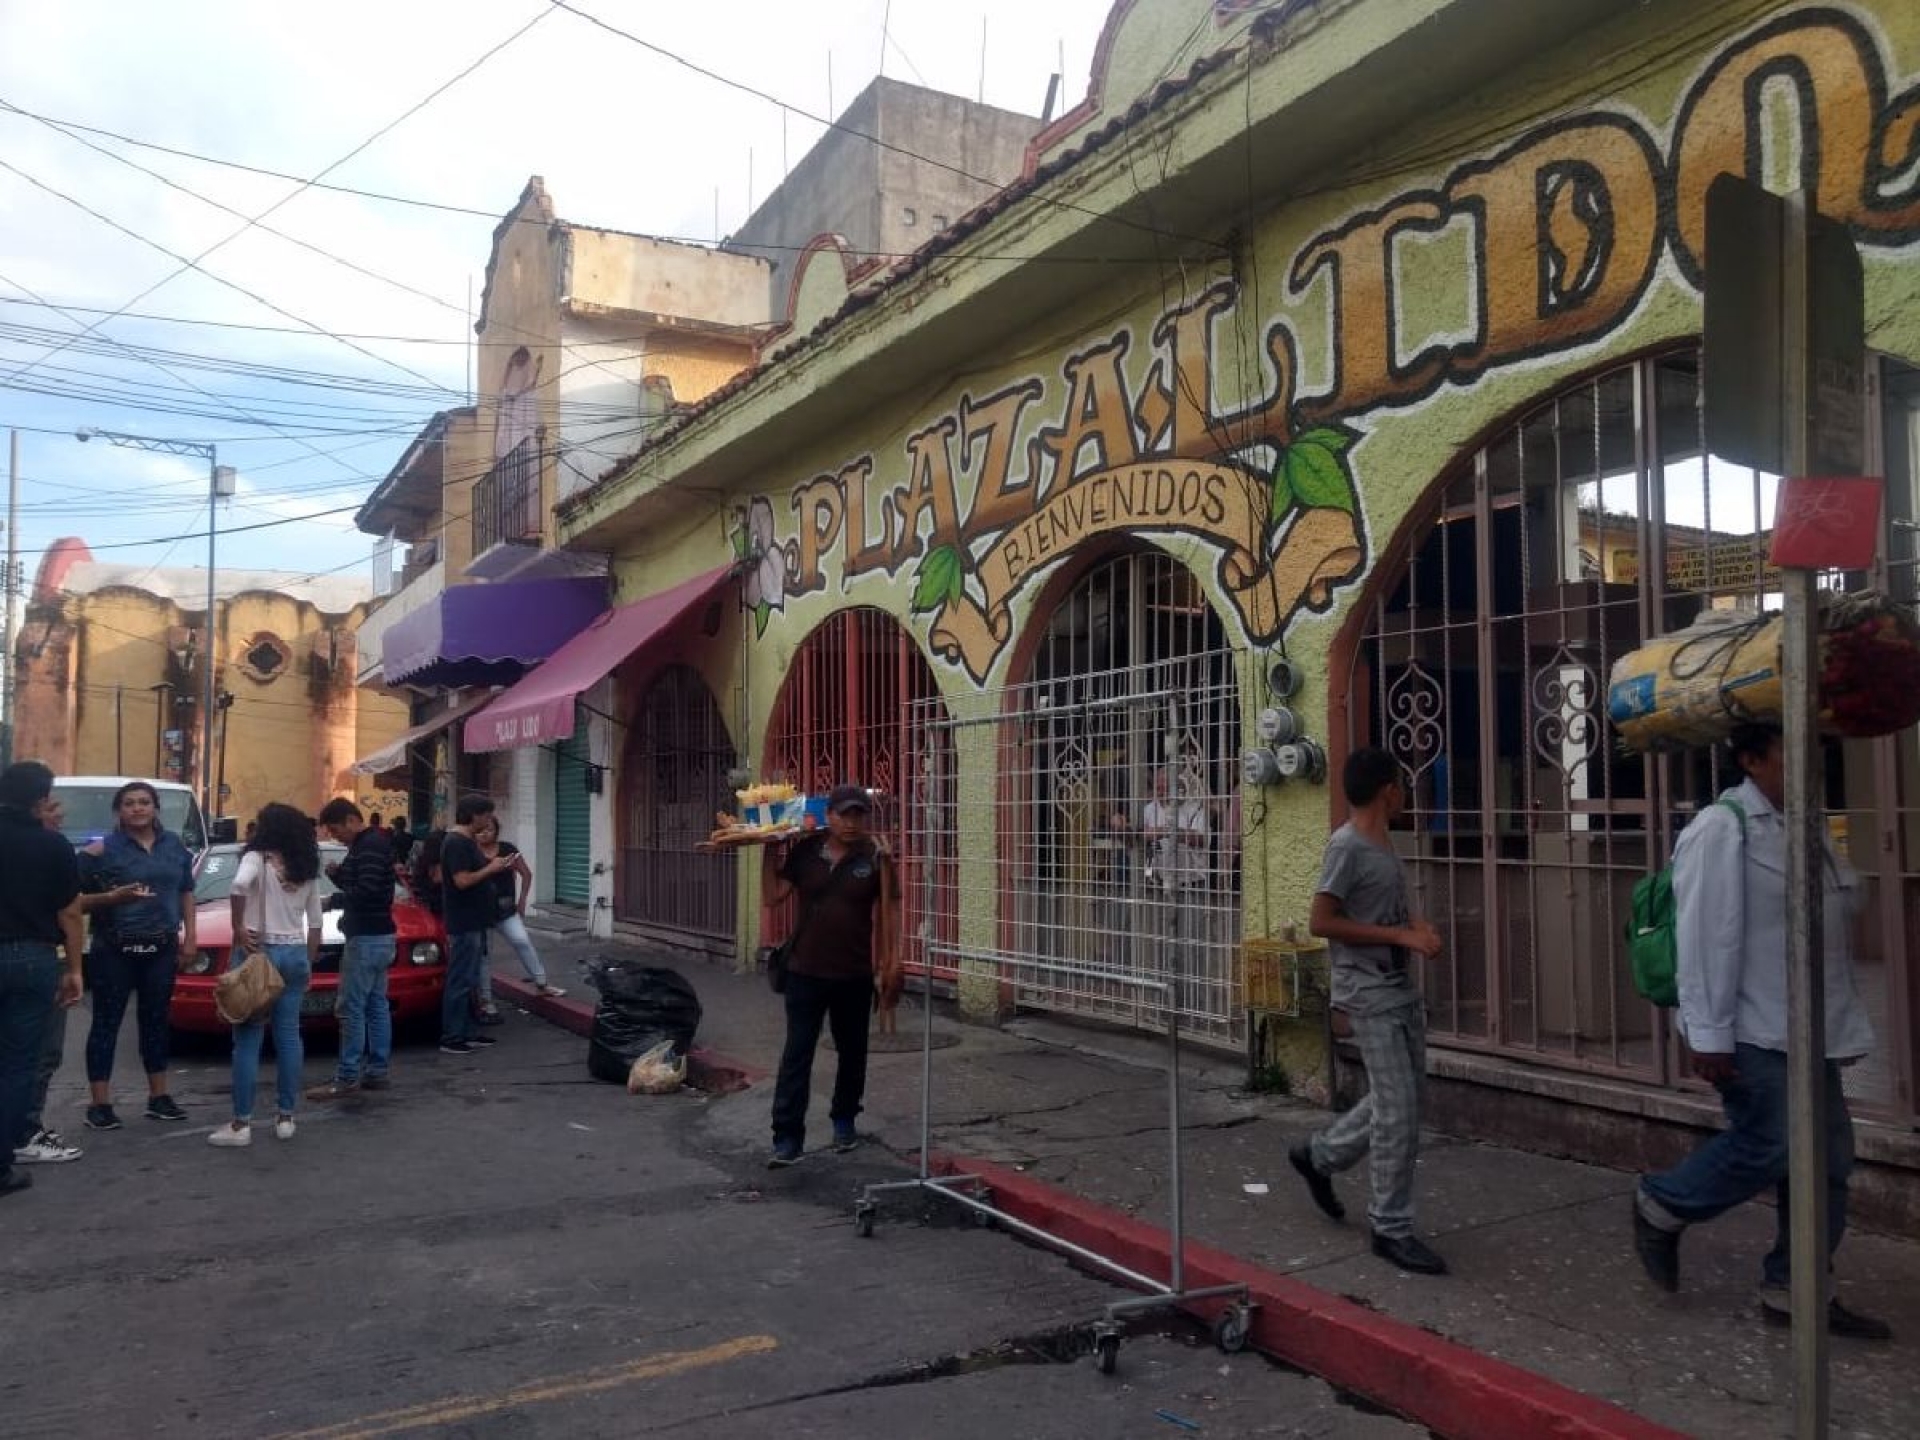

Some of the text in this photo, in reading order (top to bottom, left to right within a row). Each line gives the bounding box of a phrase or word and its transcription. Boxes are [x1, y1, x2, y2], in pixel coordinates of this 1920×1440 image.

[792, 8, 1888, 595] PLAZA LIDO
[1002, 468, 1227, 582] BIENVENIDOS
